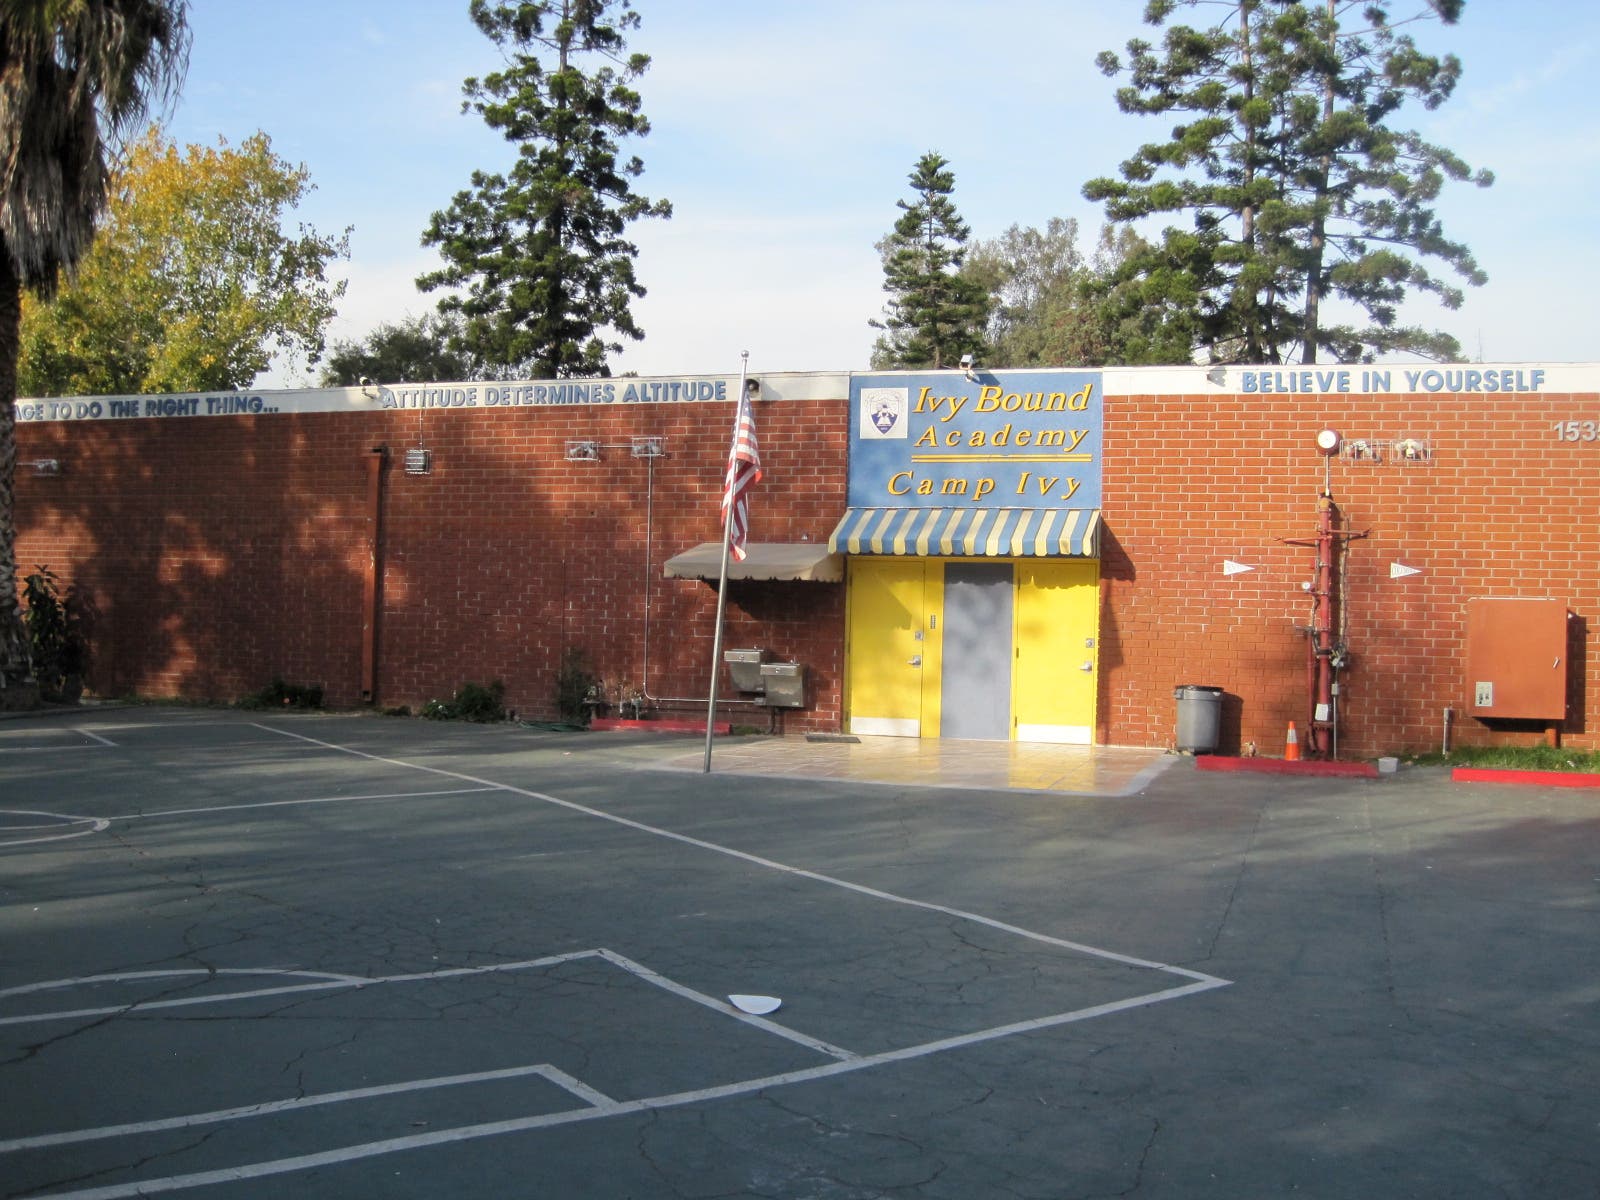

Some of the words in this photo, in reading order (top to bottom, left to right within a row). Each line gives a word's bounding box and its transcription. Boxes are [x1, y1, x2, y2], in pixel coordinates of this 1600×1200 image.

[383, 387, 477, 408] ATTITUDE
[484, 383, 615, 406] DETERMINES
[622, 380, 727, 402] ALTITUDE
[1242, 371, 1350, 393] BELIEVE
[1362, 371, 1391, 393] IN
[1404, 369, 1545, 392] YOURSELF
[49, 402, 73, 419] TO
[76, 401, 102, 418] DO
[109, 400, 140, 417] THE
[145, 398, 199, 416] RIGHT
[912, 386, 967, 422] Ivy
[973, 383, 1092, 413] Bound
[913, 423, 1089, 452] Academy
[1554, 421, 1600, 441] 153
[887, 470, 995, 501] Camp
[1016, 471, 1081, 500] Ivy
